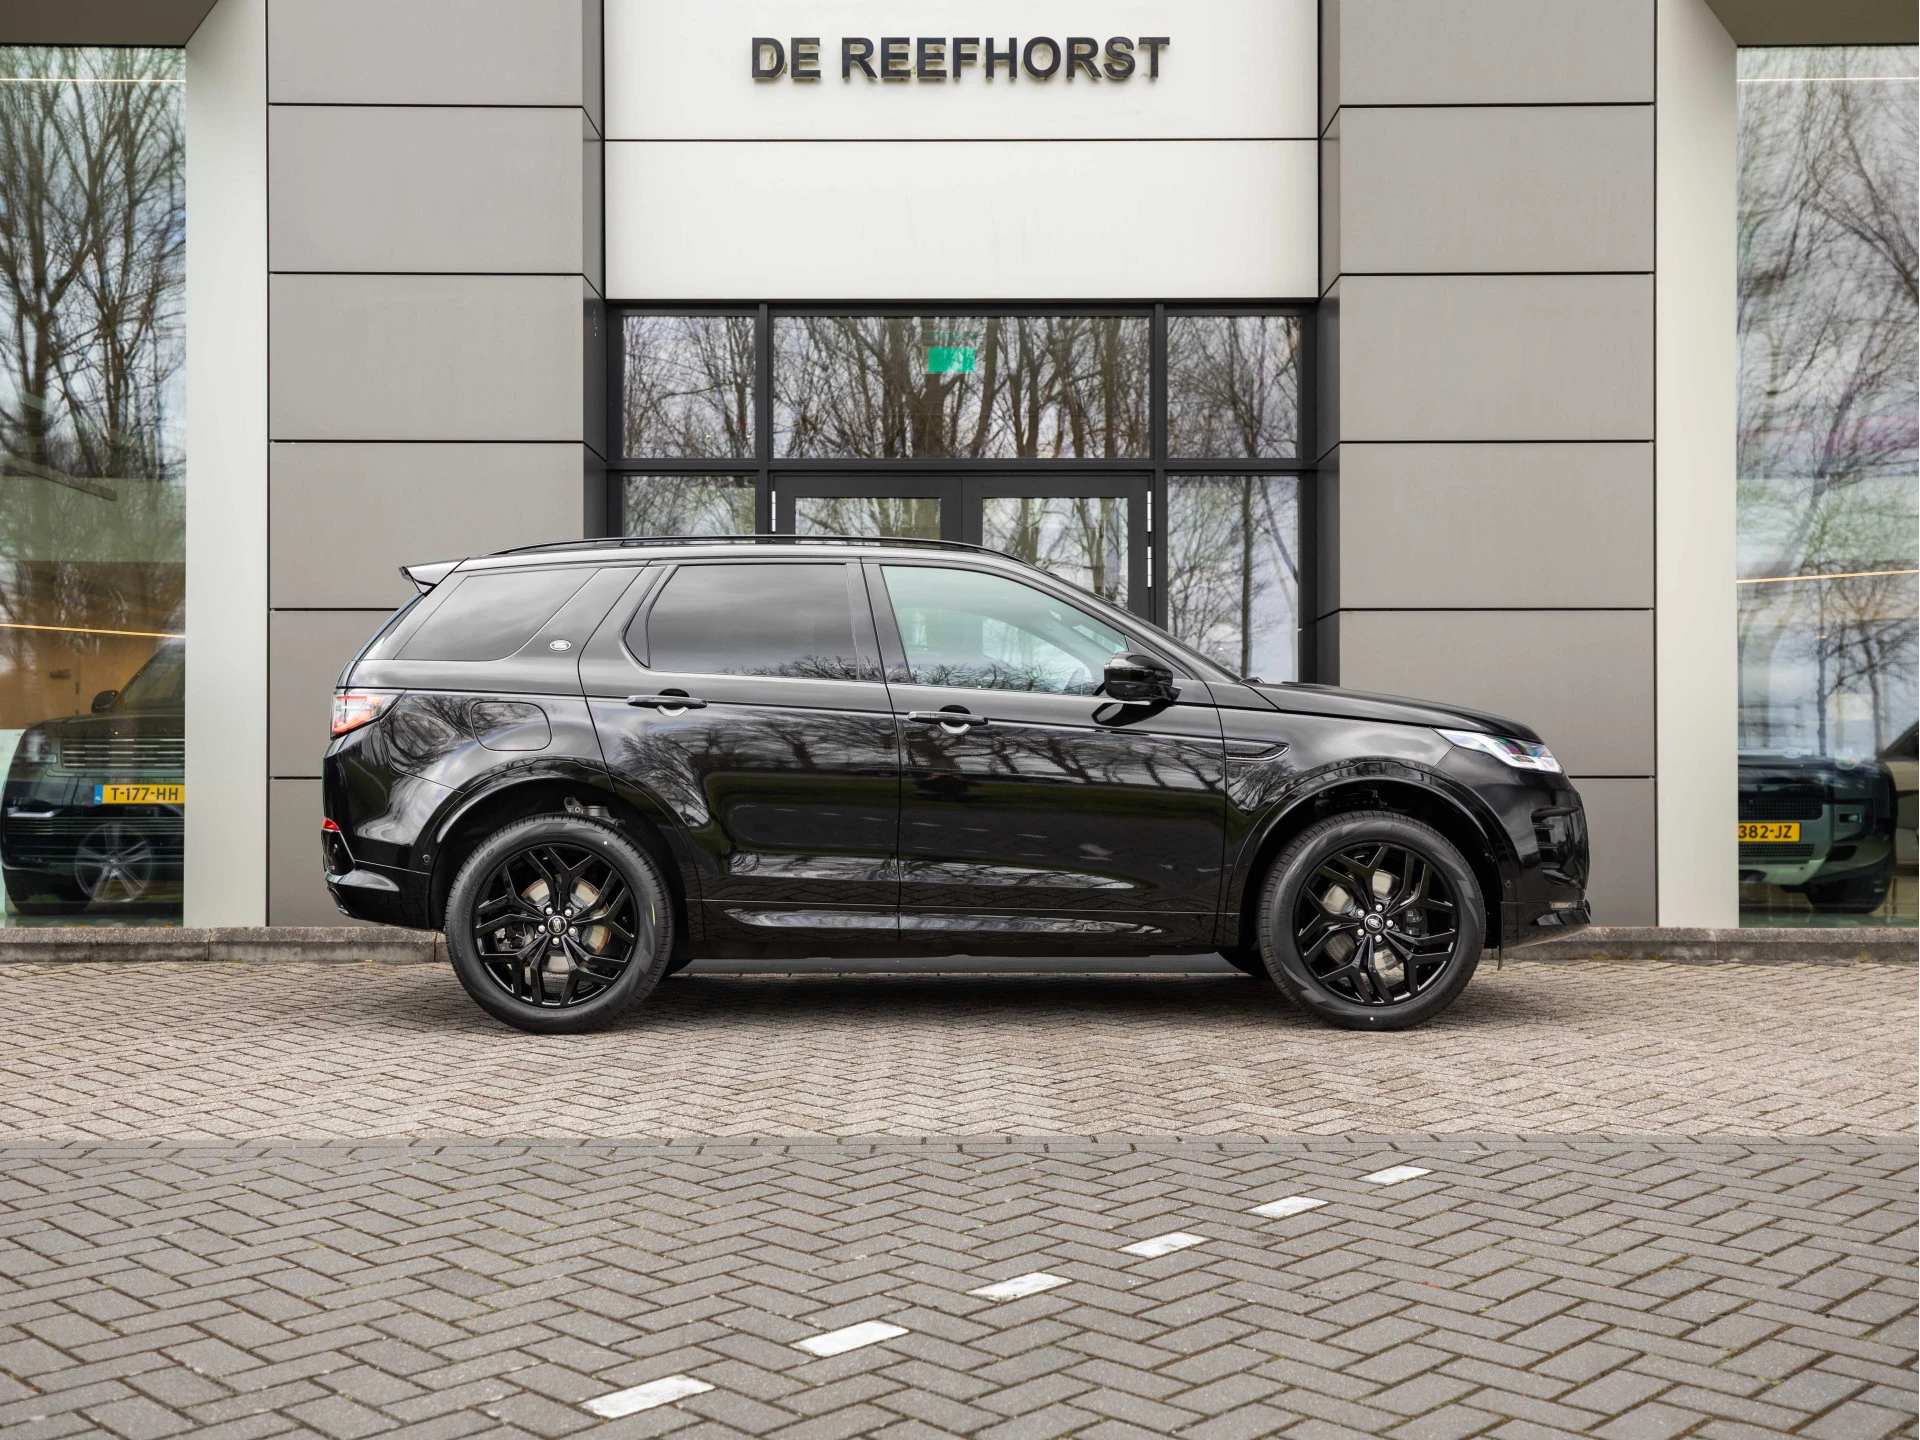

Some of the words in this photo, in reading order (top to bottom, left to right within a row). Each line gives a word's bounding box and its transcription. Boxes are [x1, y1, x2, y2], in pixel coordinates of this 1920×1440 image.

[752, 37, 821, 79] DE
[842, 36, 1170, 79] REEFHORST
[111, 788, 178, 801] T-177-HH
[1738, 825, 1792, 838] 382-JZ
